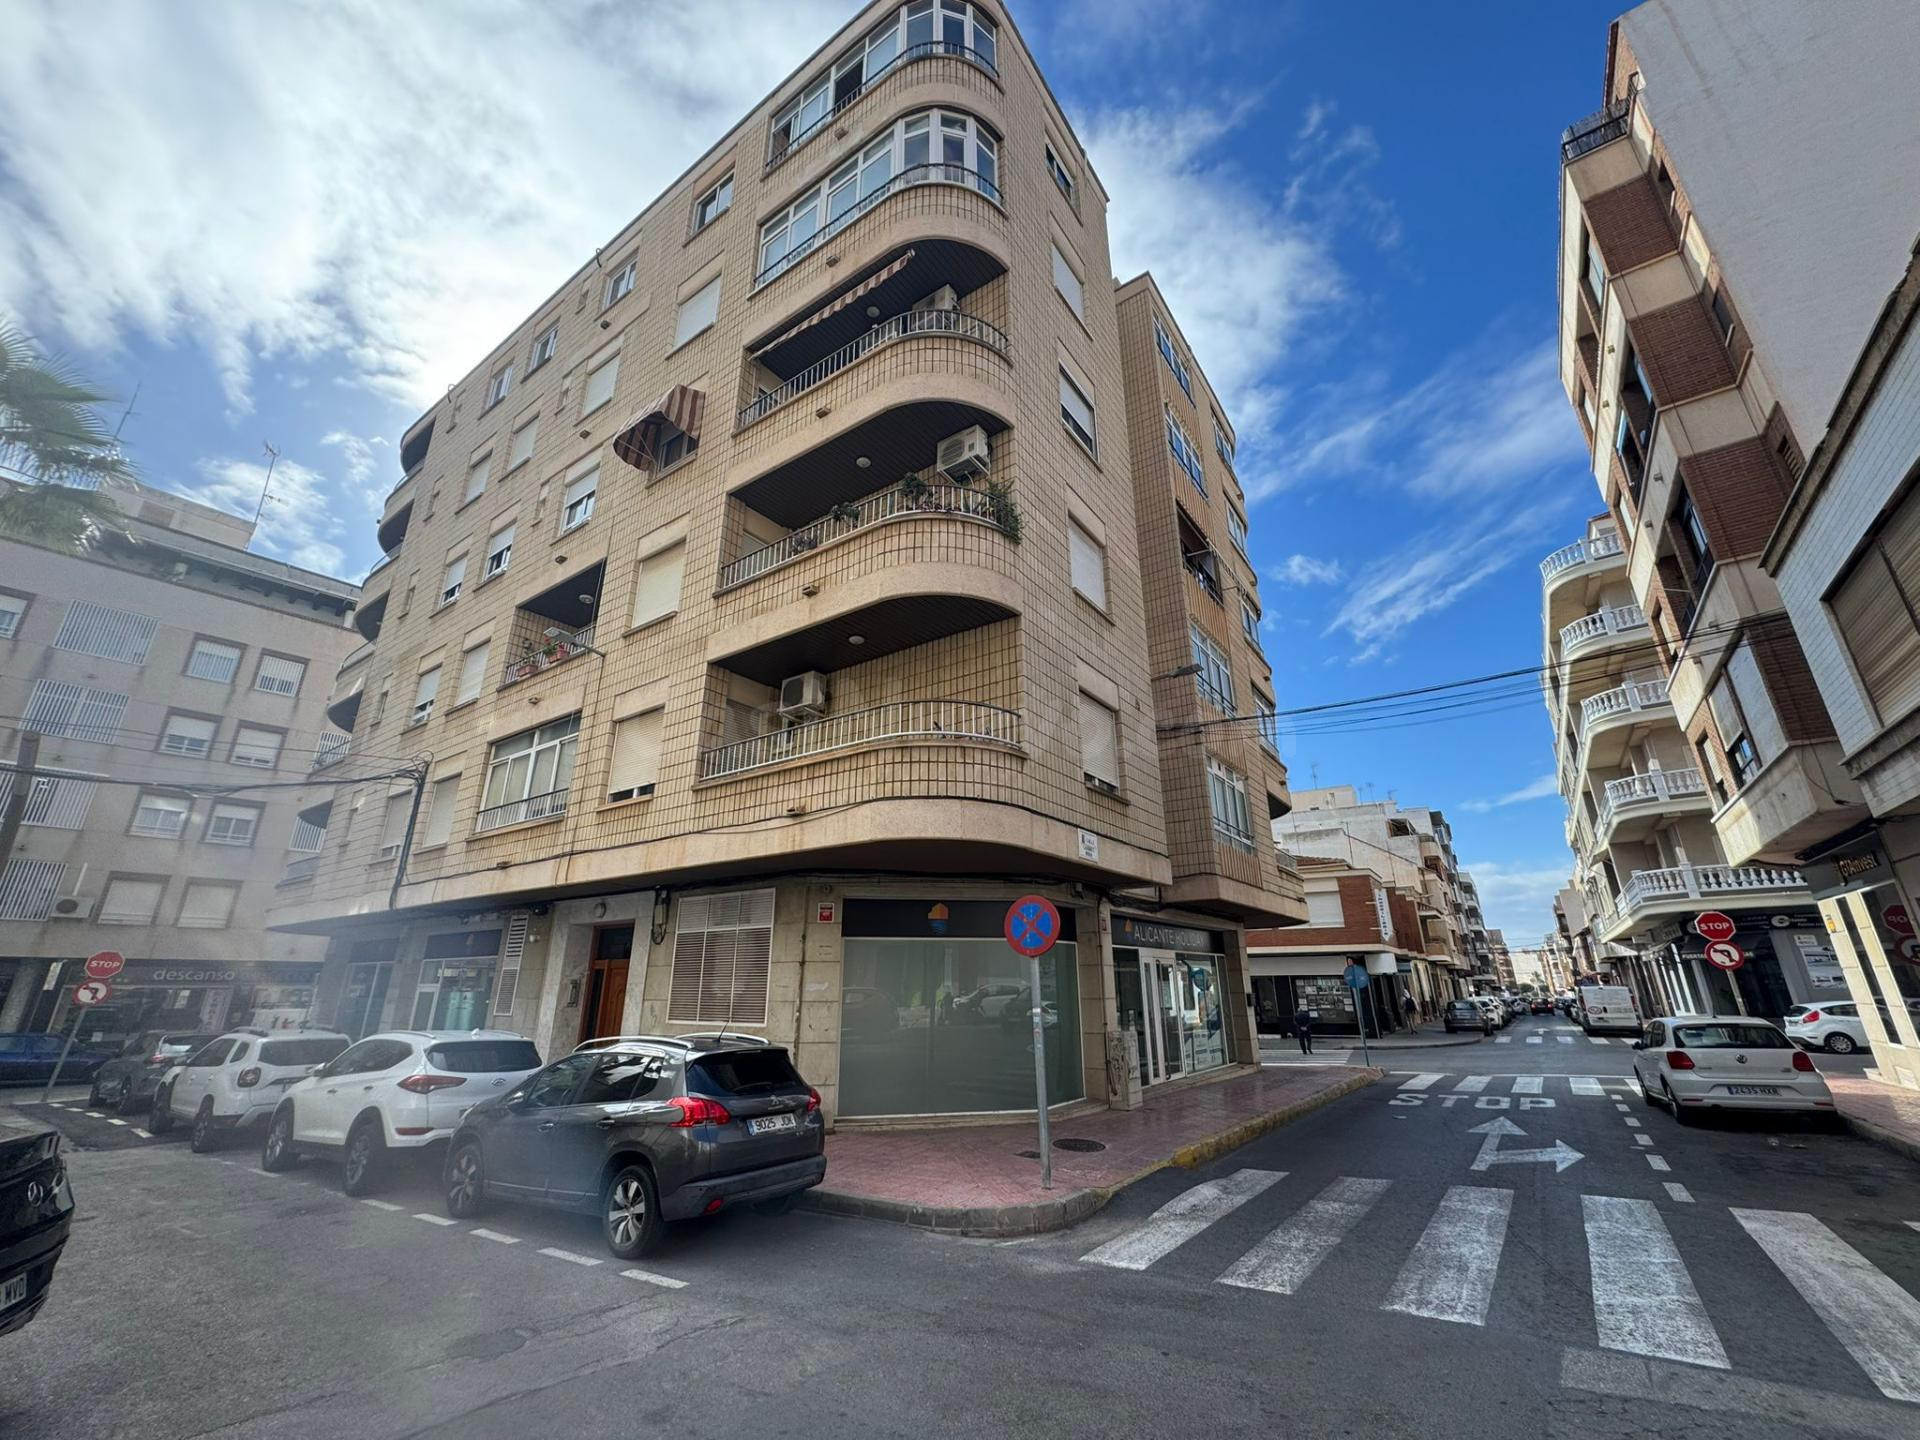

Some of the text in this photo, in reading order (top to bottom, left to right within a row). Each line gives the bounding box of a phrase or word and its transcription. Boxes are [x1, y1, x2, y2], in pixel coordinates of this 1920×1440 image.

[1700, 922, 1730, 931] STOP
[1134, 925, 1175, 945] ALICANTE
[89, 960, 120, 969] STOP
[153, 968, 236, 982] descanso
[1388, 1093, 1557, 1111] STOP
[755, 1117, 777, 1131] 9025
